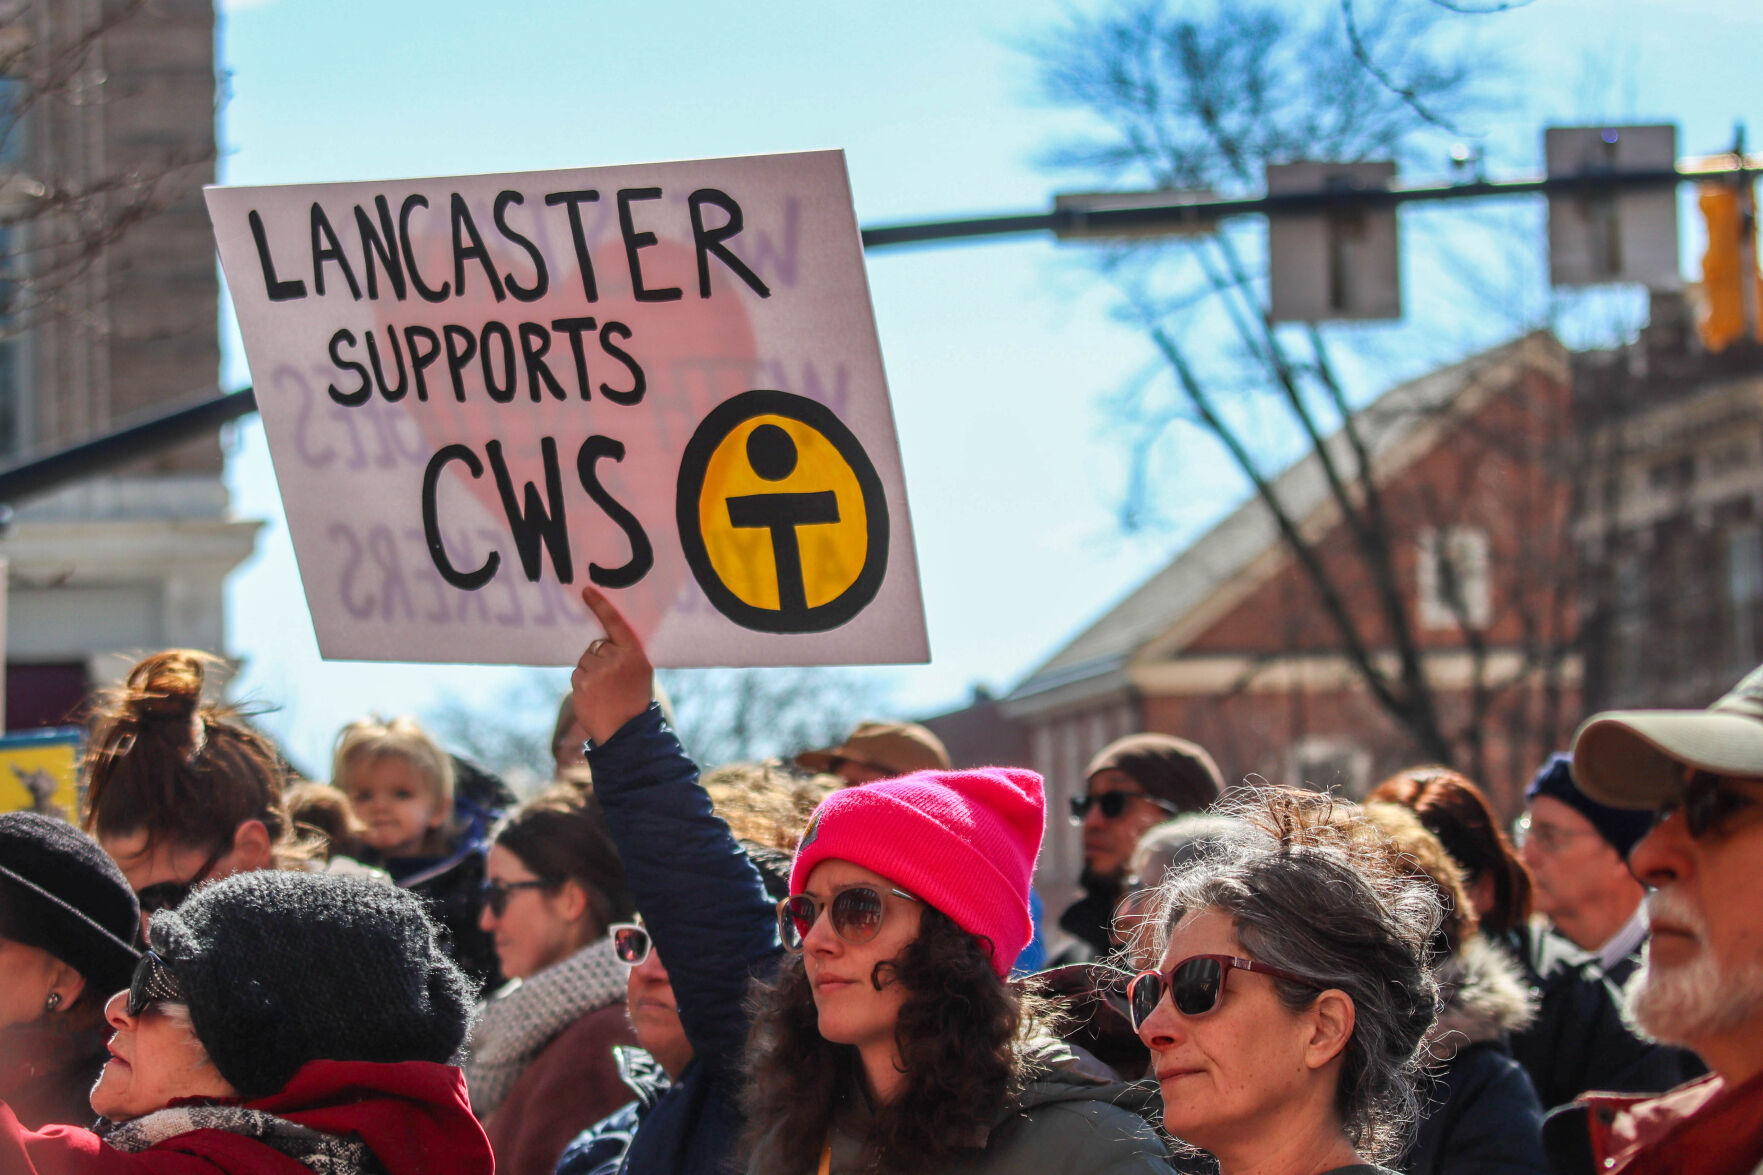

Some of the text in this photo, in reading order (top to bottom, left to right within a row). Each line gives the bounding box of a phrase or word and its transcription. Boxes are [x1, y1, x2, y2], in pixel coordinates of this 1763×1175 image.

[248, 187, 771, 303] LANCASTER
[328, 316, 647, 407] SUPPORTS
[421, 434, 654, 591] CWS
